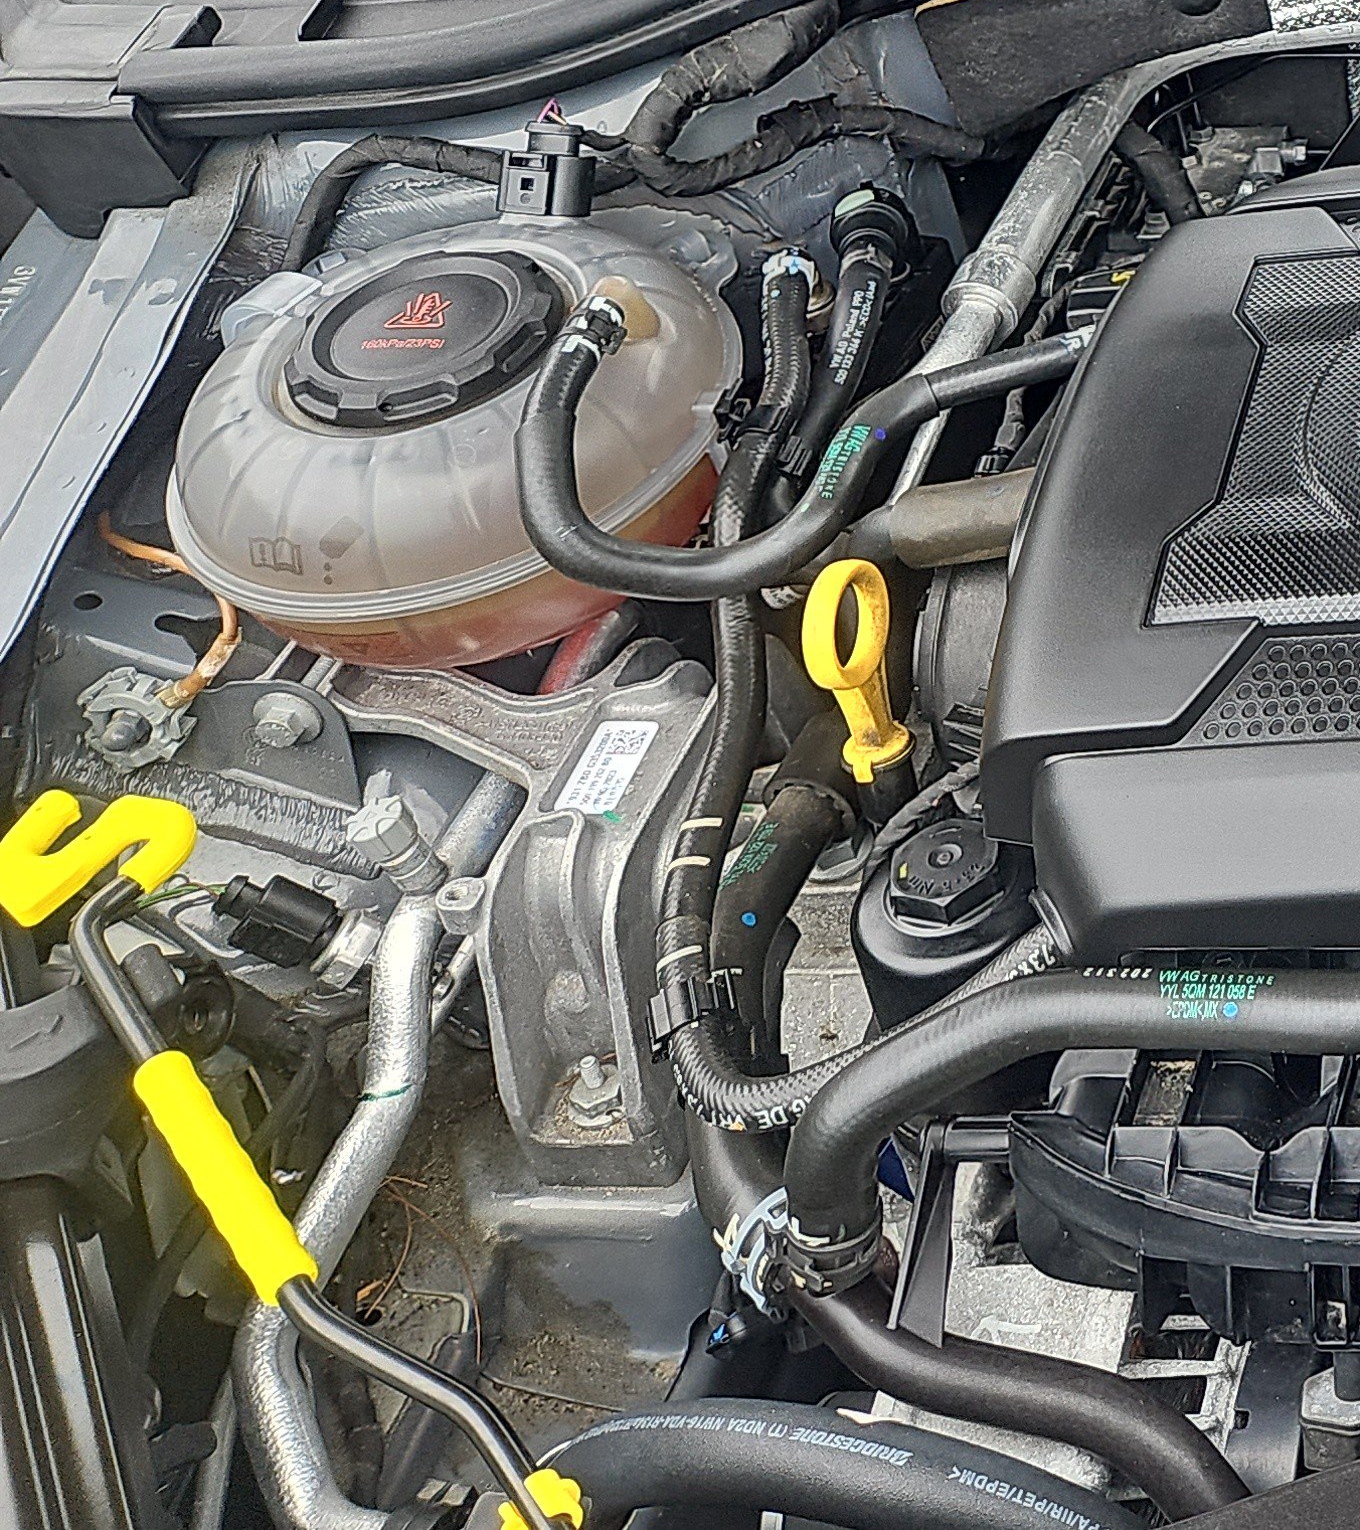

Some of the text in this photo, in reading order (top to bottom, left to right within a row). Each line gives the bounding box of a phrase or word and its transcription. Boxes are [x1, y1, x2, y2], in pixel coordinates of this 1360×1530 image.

[1180, 971, 1201, 981] AG
[1202, 975, 1275, 985] TRISTONE
[1208, 985, 1225, 999] 121
[1227, 985, 1245, 1000] 058
[1247, 985, 1256, 1000] E
[755, 1106, 788, 1129] DE
[788, 1427, 913, 1465] BRIDGESTONE
